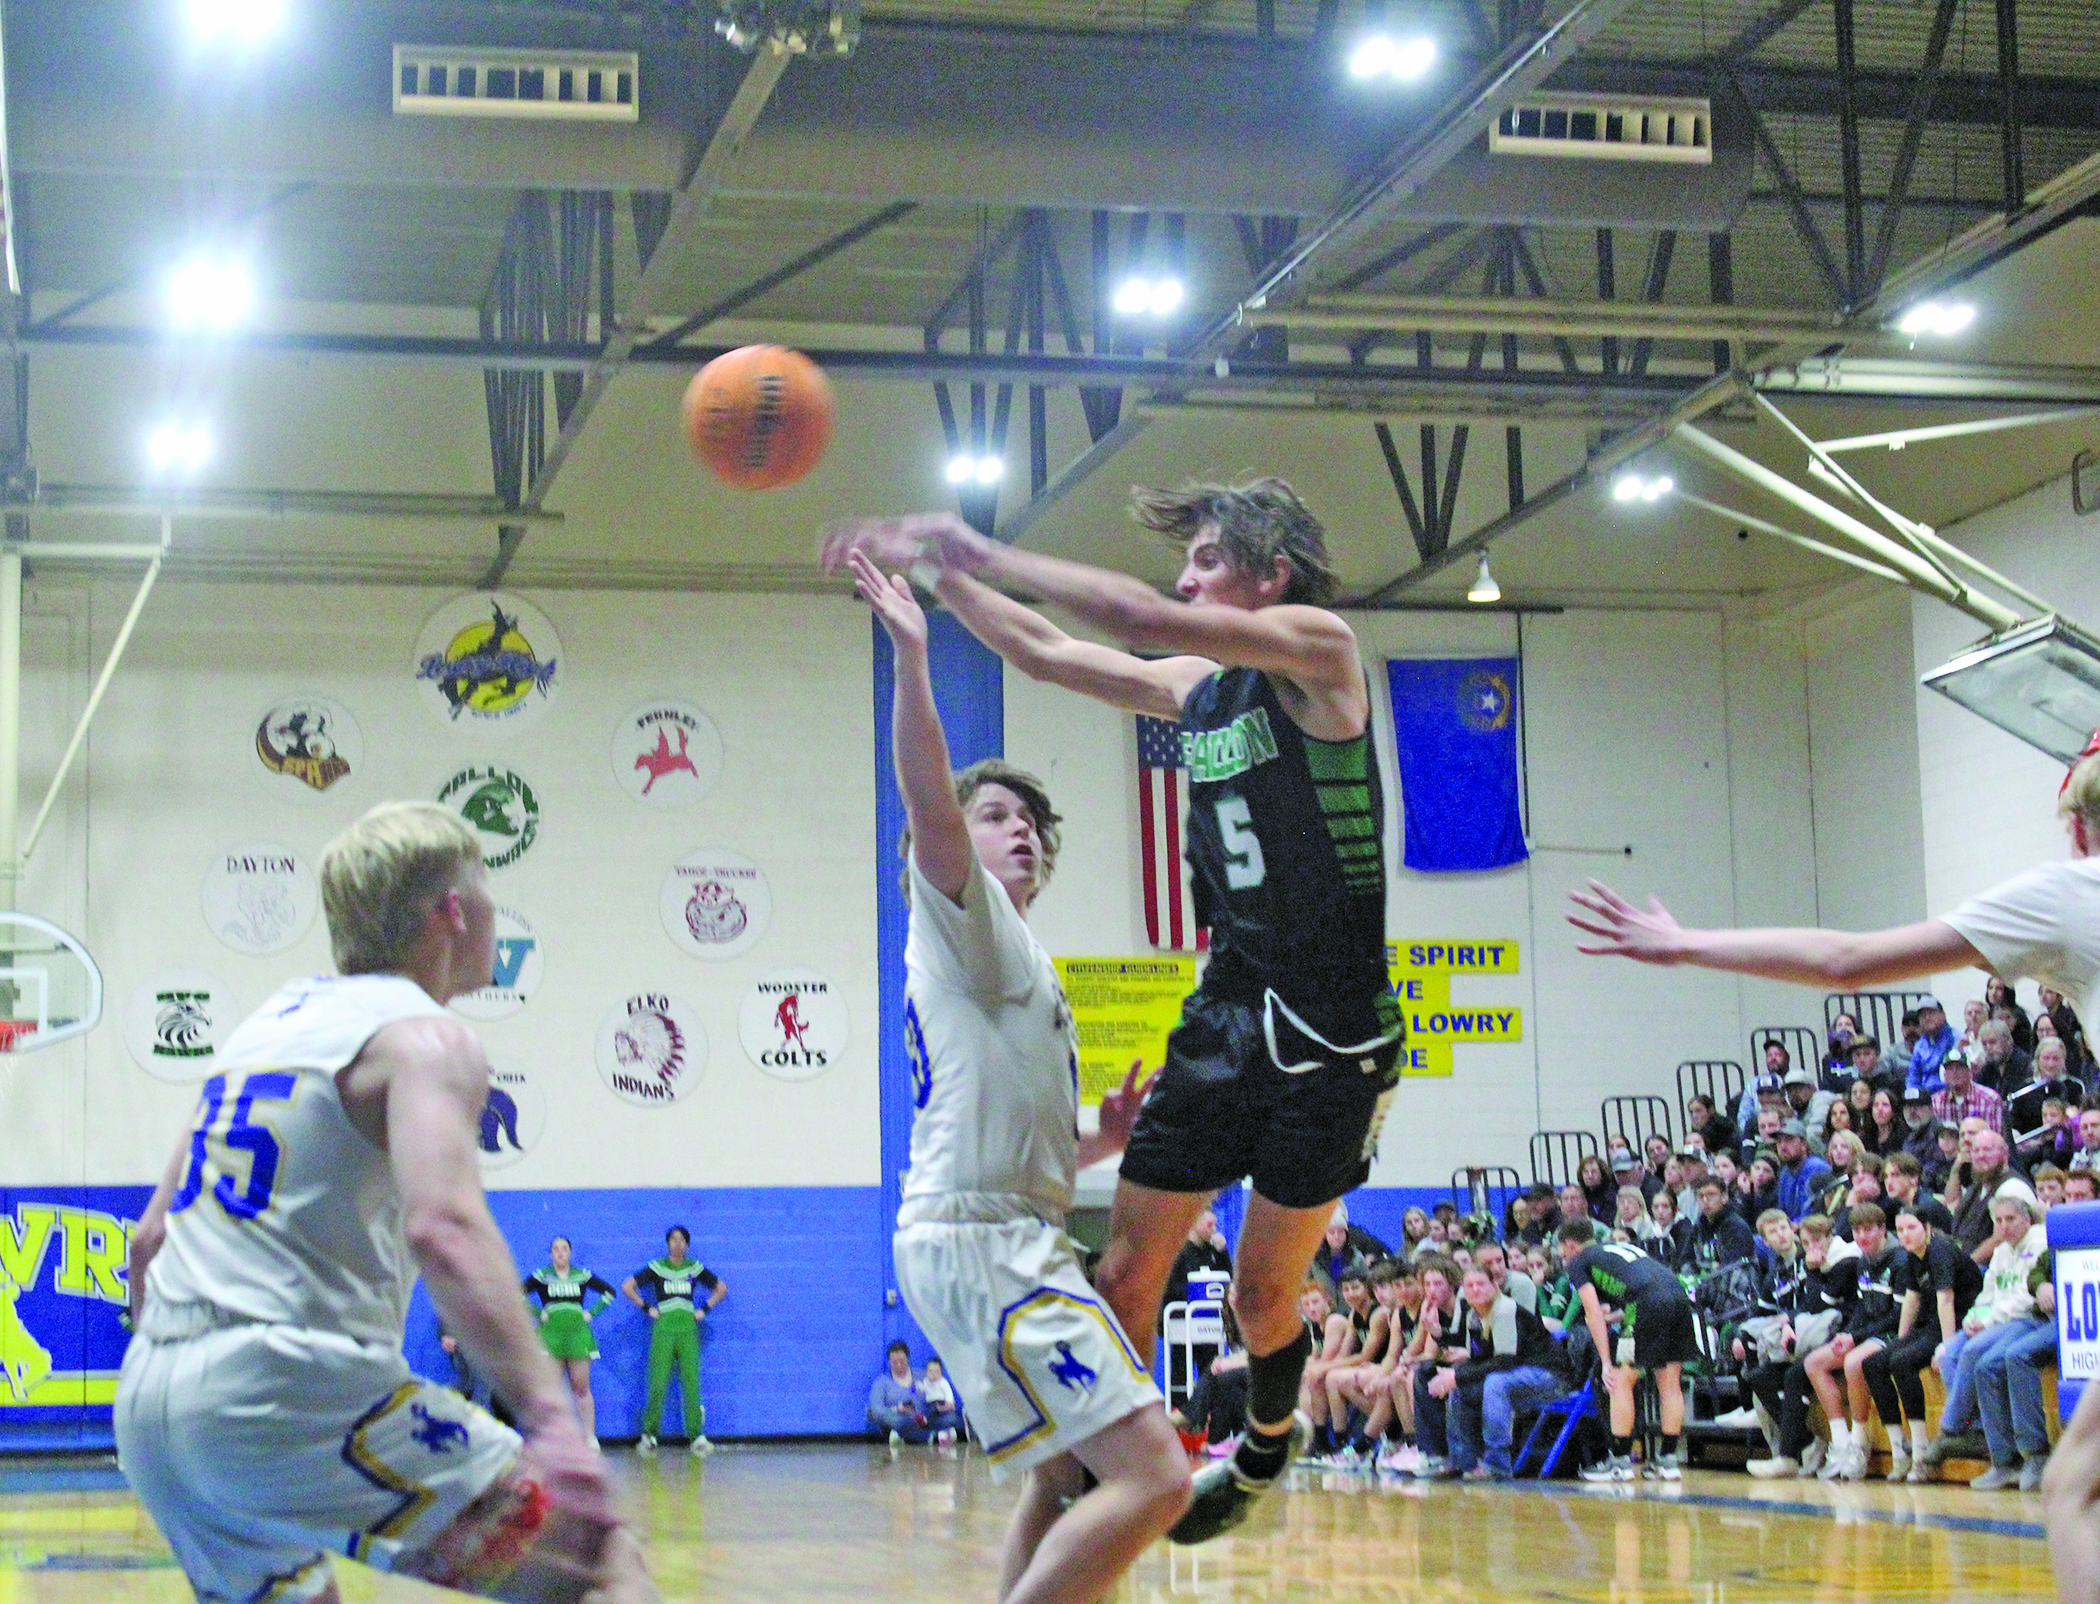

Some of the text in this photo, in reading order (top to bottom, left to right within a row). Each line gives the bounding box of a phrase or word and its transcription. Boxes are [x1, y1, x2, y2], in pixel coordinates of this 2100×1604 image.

[1213, 795, 1266, 890] 5
[227, 854, 296, 875] DAYTON
[1409, 944, 1506, 967] SPIRIT
[757, 981, 829, 994] WOOSTER
[626, 992, 670, 1016] ELKO
[1412, 1012, 1514, 1034] LOWRY
[760, 1050, 828, 1068] COLTS
[612, 1073, 675, 1102] INDIANS
[168, 1072, 299, 1220] 15
[2063, 1281, 2100, 1342] LO
